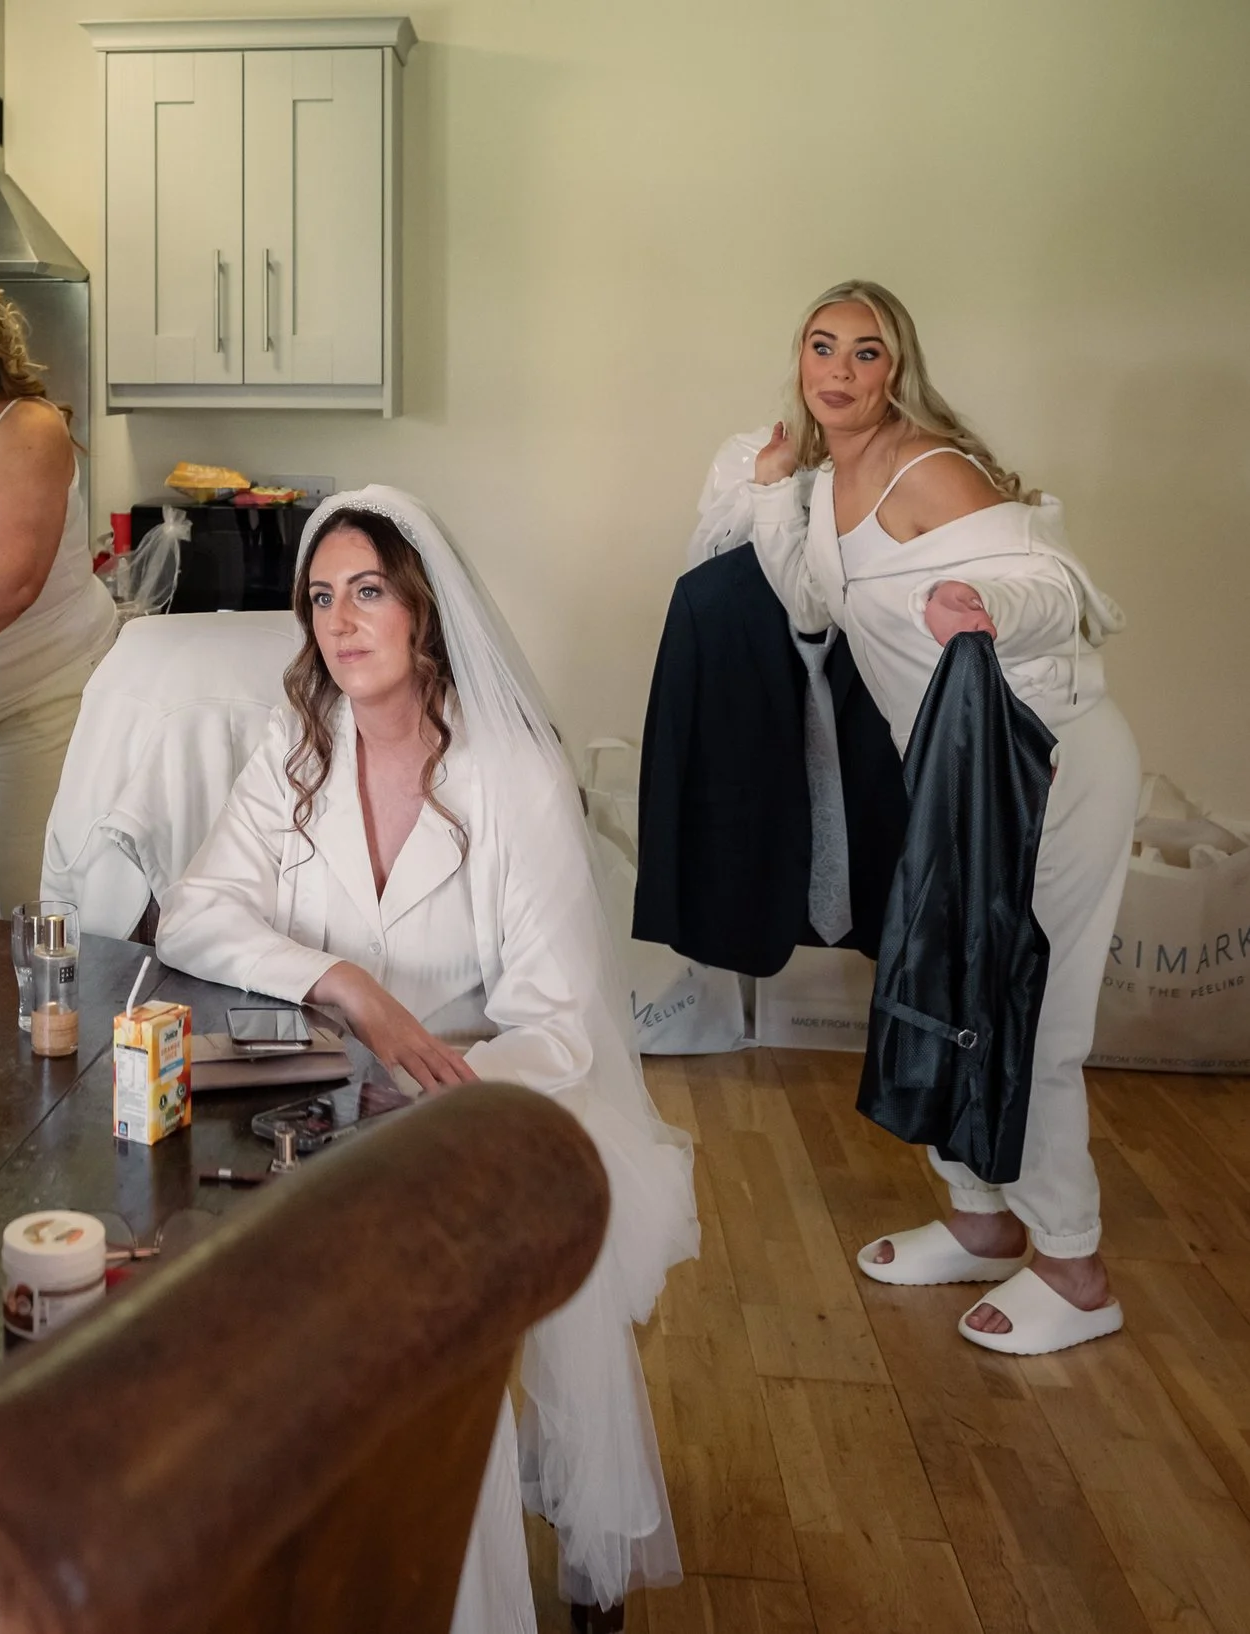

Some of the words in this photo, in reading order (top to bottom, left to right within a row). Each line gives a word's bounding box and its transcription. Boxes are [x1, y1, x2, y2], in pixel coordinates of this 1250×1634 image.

[1109, 927, 1250, 974] RIMARK
[1103, 975, 1136, 993] OVE
[1148, 986, 1181, 998] THE
[1190, 975, 1245, 998] FEELING
[645, 994, 696, 1028] EELING
[791, 1016, 820, 1028] MADE
[820, 1017, 851, 1030] FROM
[853, 1019, 869, 1031] 100
